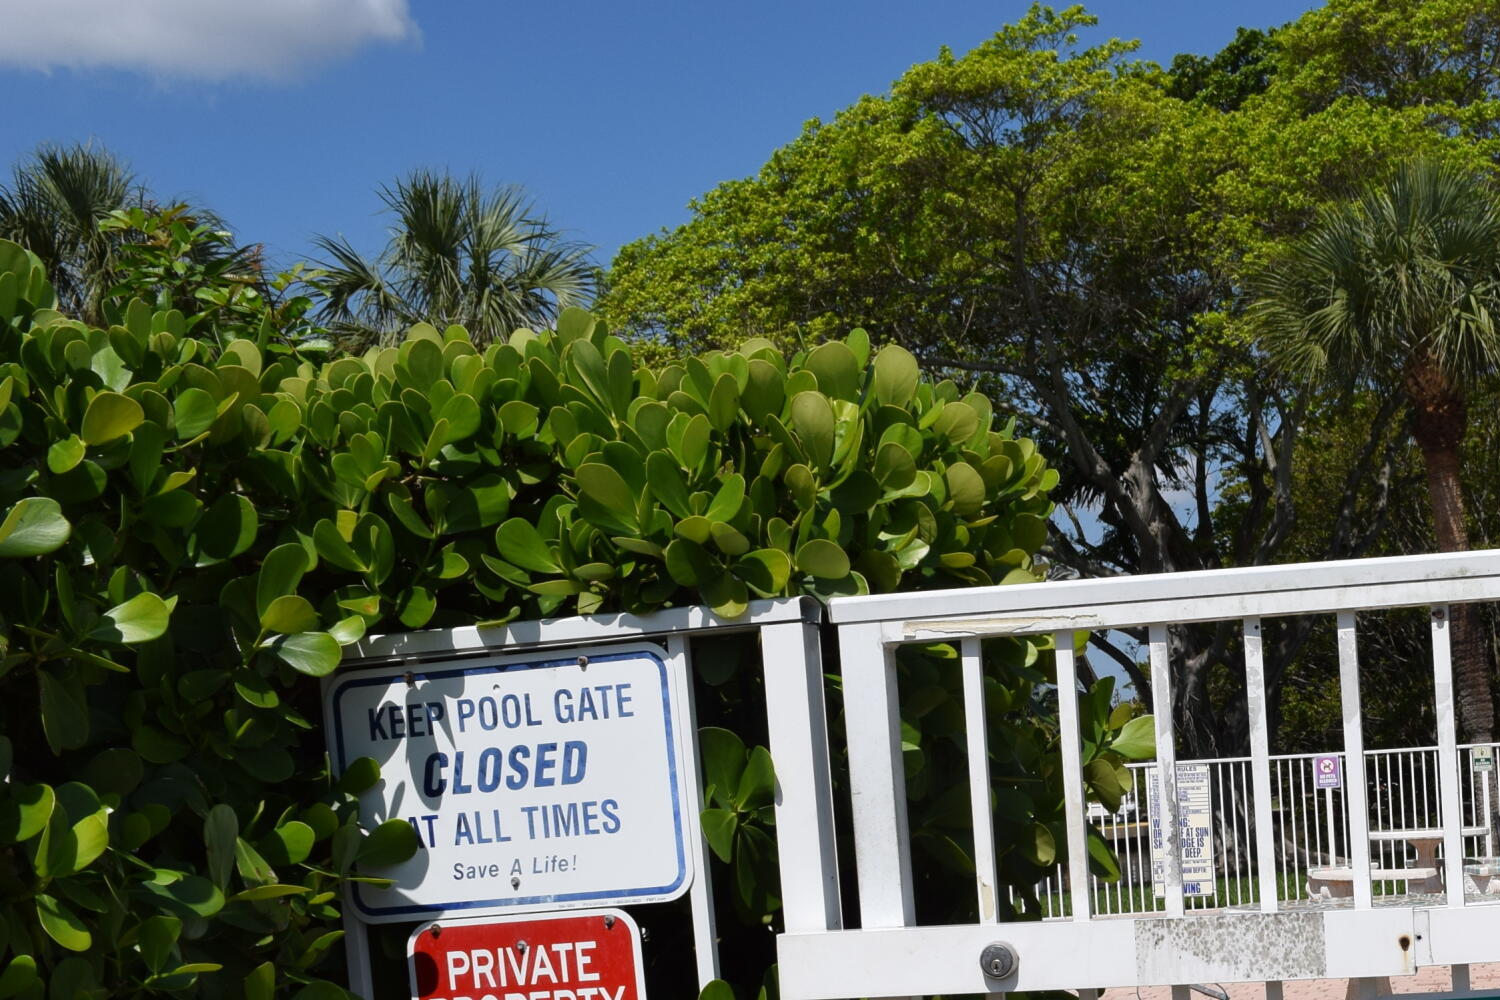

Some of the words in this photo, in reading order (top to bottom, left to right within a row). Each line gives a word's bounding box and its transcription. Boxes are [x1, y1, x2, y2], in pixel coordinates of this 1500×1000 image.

[368, 702, 445, 741] KEEP
[457, 694, 542, 732] POOL
[554, 684, 633, 723] GATE
[423, 741, 586, 798] CLOSED
[455, 810, 511, 845] ALL
[521, 799, 620, 839] TIMES
[1196, 827, 1209, 837] SUN
[453, 863, 499, 880] Save
[510, 859, 522, 875] A
[533, 855, 576, 874] Life!
[447, 941, 600, 990] PRIVATE
